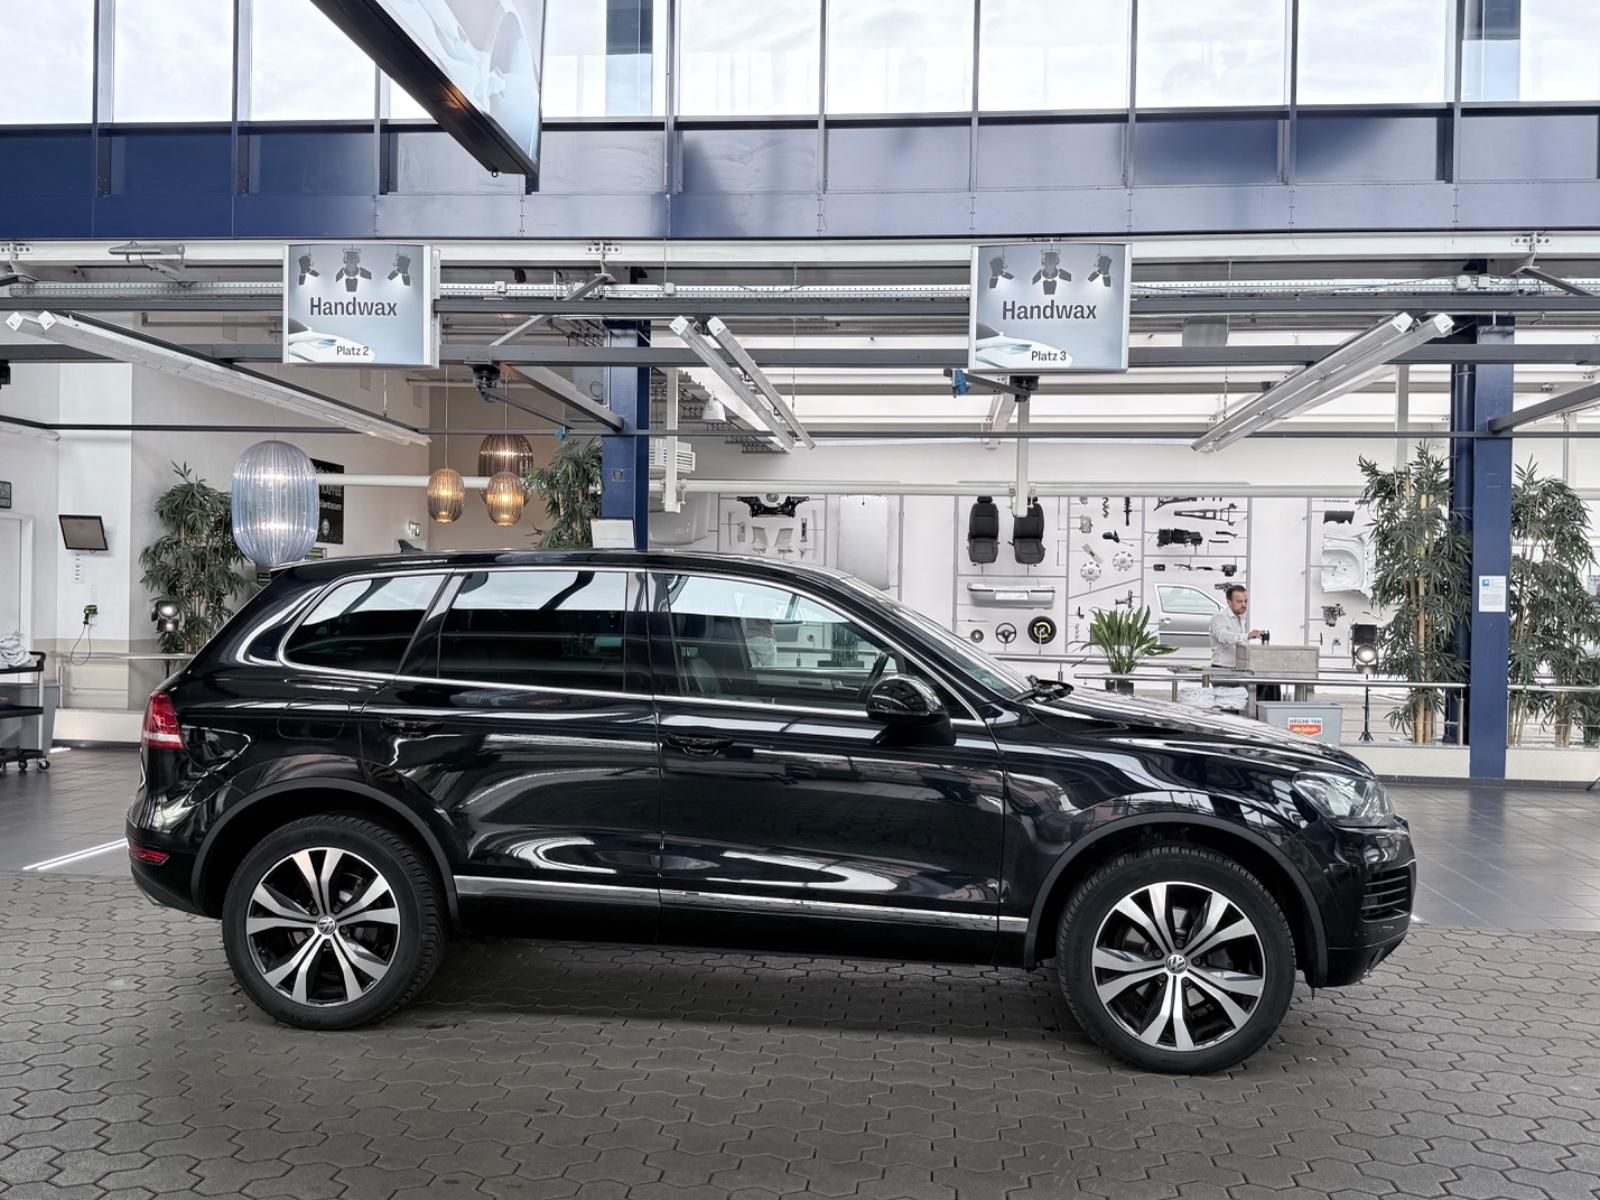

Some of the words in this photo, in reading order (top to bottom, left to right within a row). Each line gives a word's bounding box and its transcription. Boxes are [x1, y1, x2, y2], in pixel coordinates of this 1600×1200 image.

[309, 296, 398, 317] Handwax
[1001, 299, 1098, 320] Handwax
[336, 345, 361, 356] Platz
[362, 345, 370, 356] 2
[1031, 350, 1058, 362] Platz
[1059, 350, 1067, 362] 3
